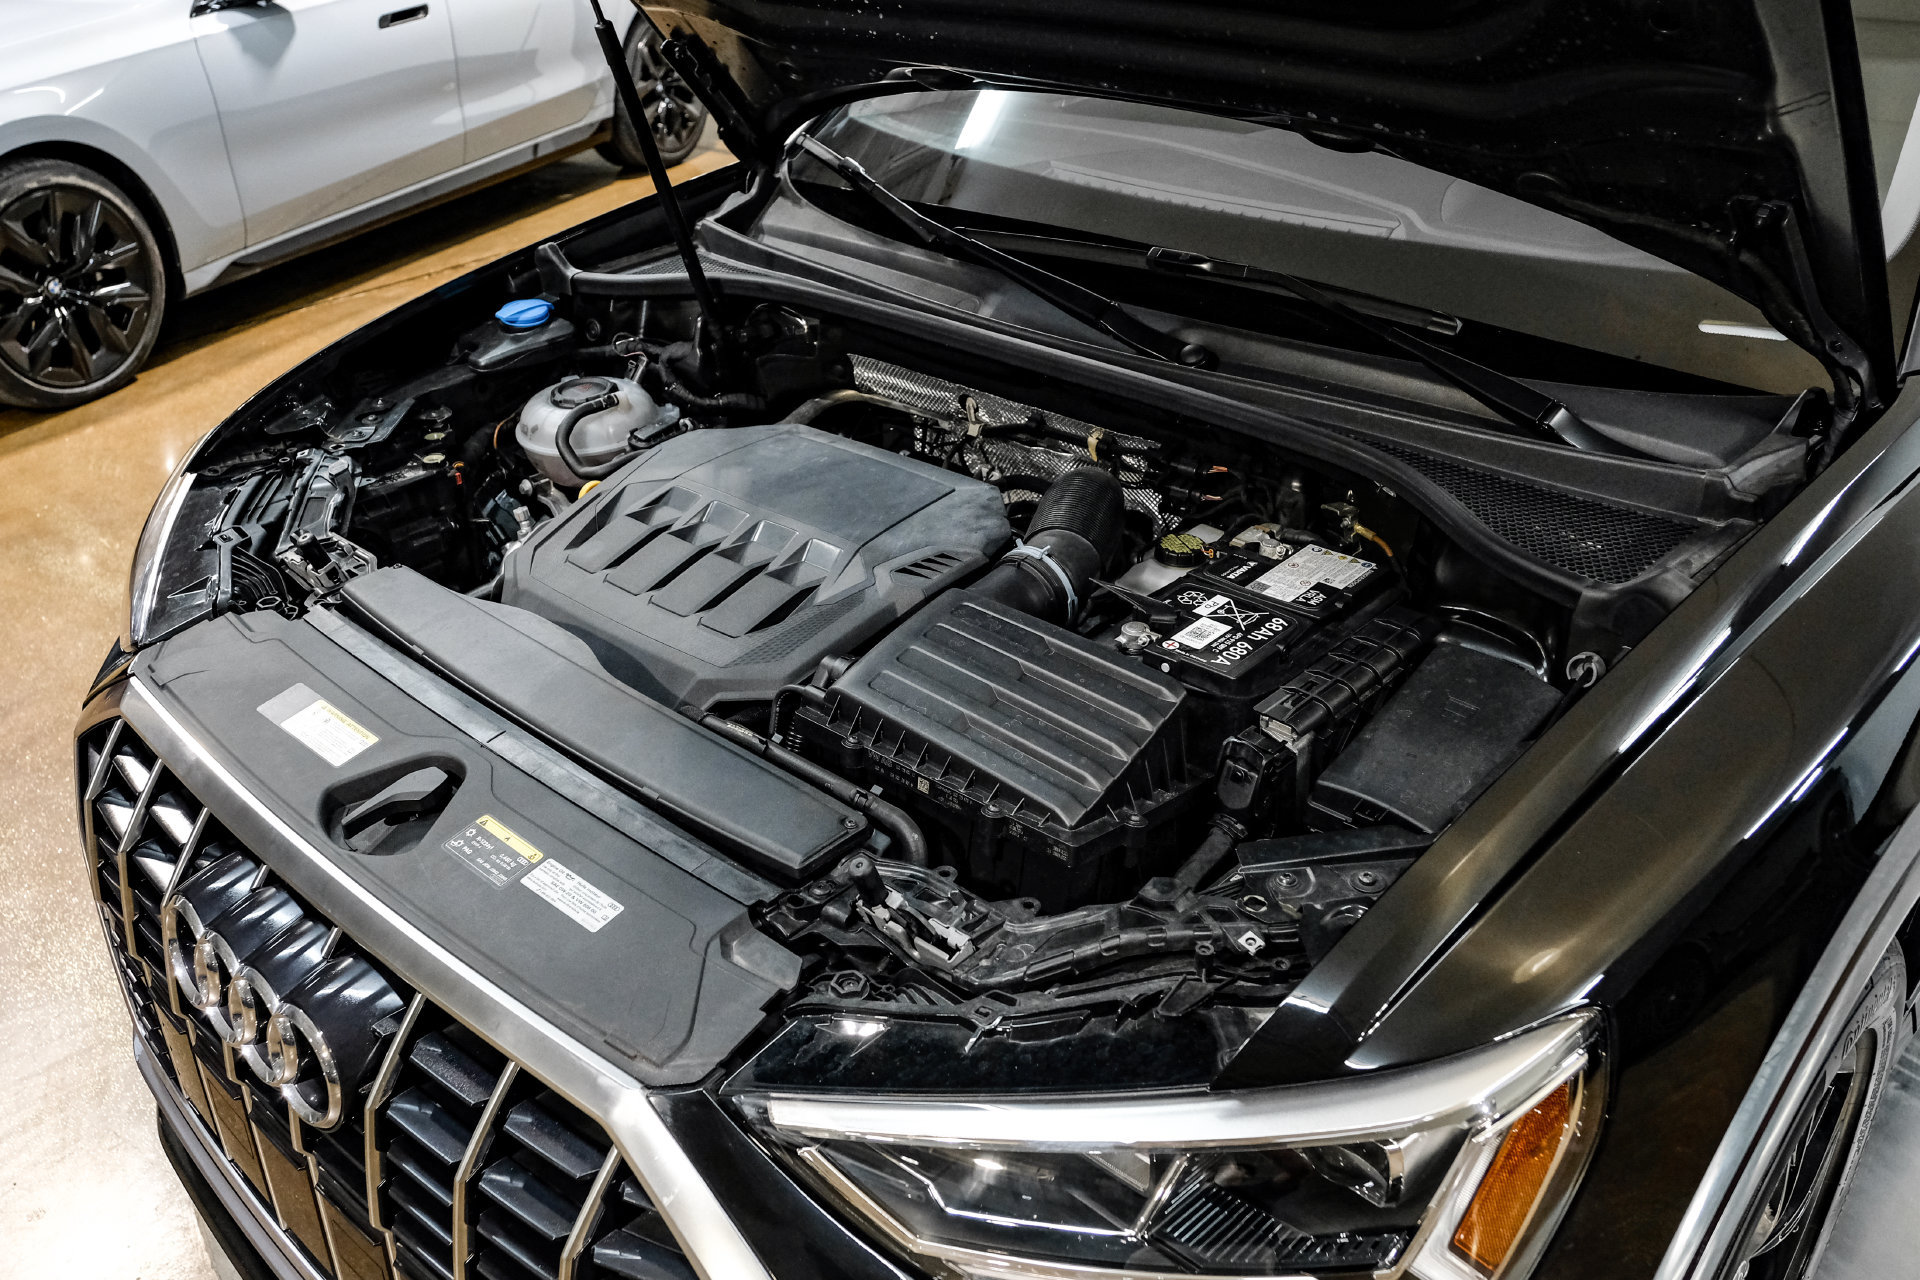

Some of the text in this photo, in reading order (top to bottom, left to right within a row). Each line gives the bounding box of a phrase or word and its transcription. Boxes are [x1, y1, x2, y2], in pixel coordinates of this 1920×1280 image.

[1226, 565, 1251, 579] VARTA
[1247, 617, 1288, 640] 68Ah
[1210, 641, 1253, 666] 680A
[462, 846, 472, 855] PAG
[547, 860, 558, 870] Engine
